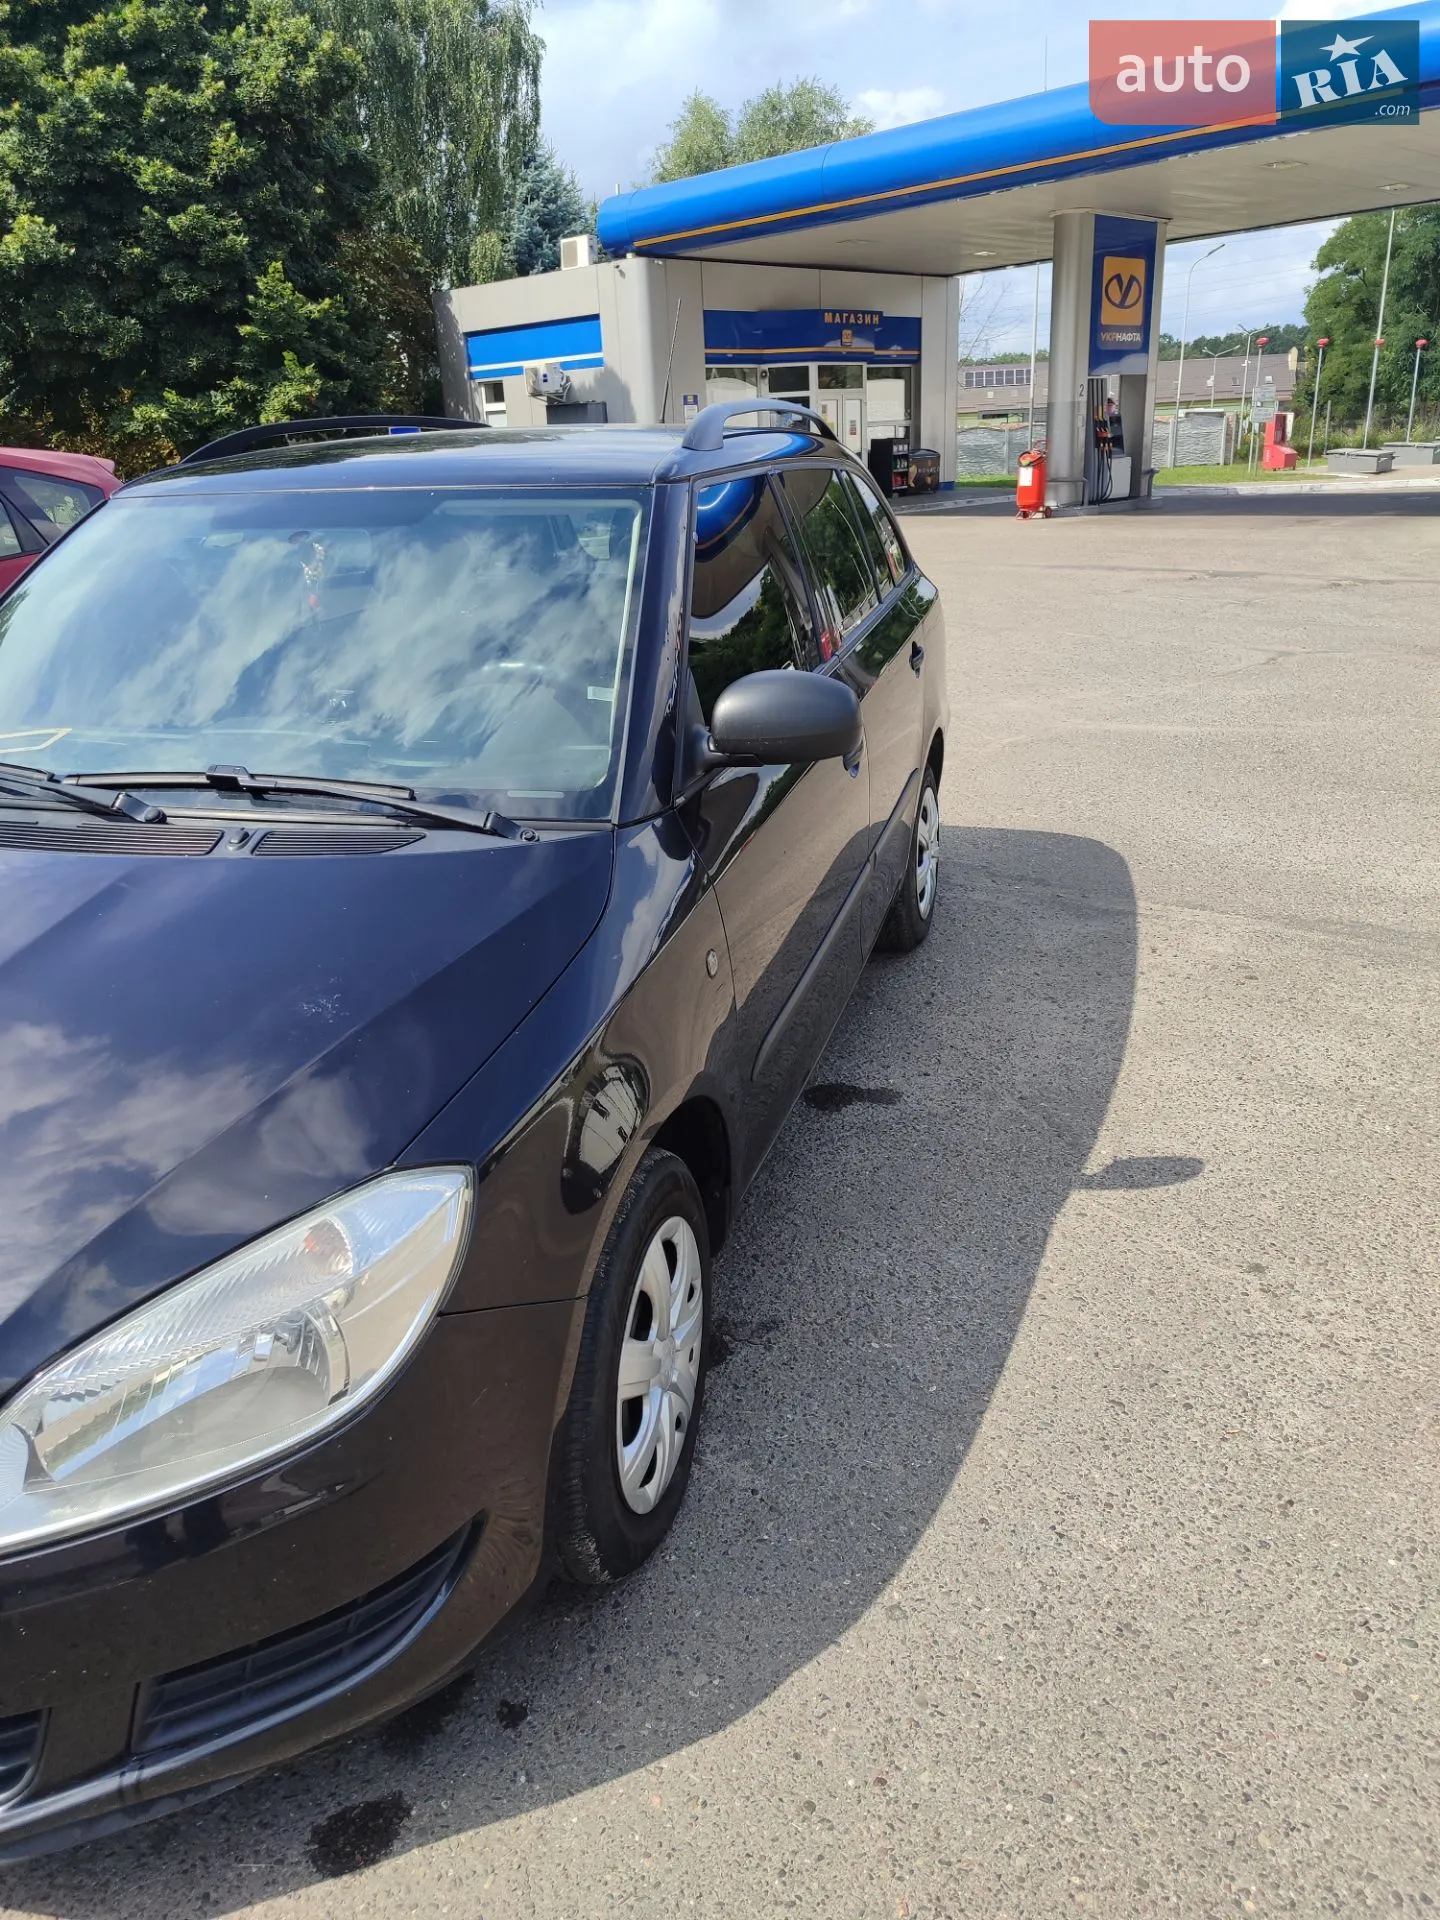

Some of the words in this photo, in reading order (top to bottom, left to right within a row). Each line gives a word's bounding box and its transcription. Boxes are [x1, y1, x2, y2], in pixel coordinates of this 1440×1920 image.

[824, 311, 879, 325] МАГАЗИН
[1100, 331, 1141, 342] УКРНАФТА
[1079, 383, 1085, 397] 2
